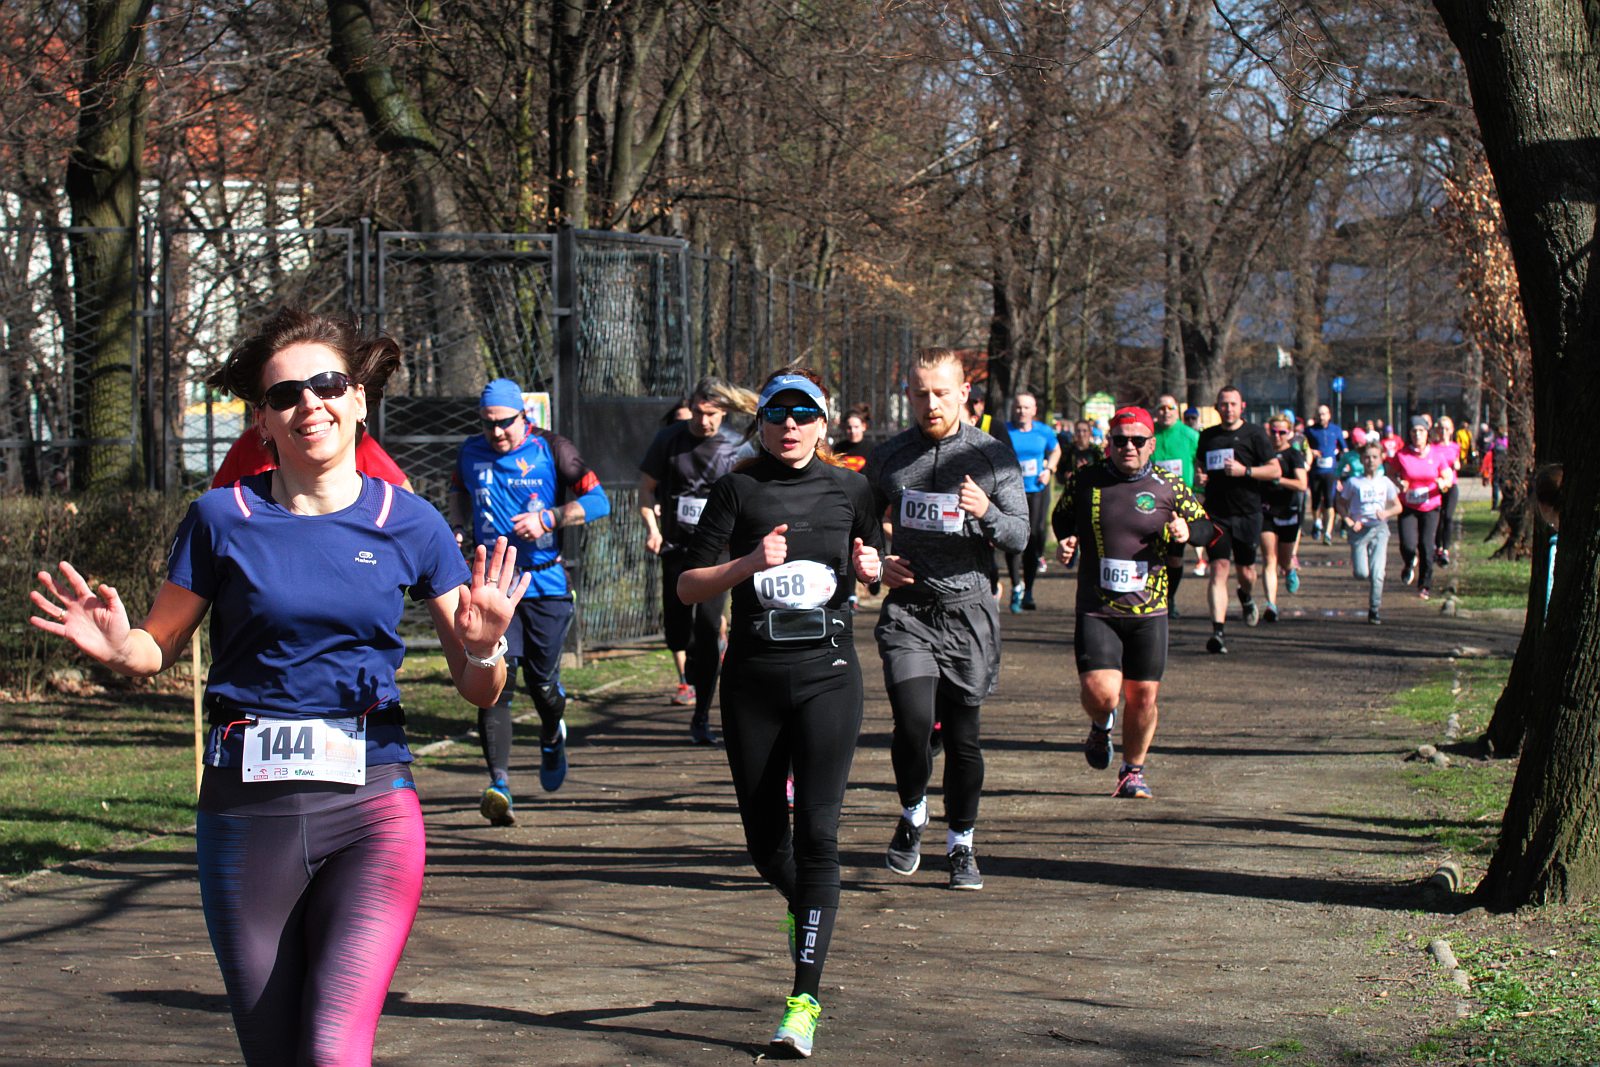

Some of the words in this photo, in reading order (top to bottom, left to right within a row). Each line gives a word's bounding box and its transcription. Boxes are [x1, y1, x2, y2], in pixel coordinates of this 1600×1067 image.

[682, 505, 702, 518] 057
[905, 501, 939, 521] 026
[1103, 567, 1129, 583] 065
[760, 573, 805, 601] 058
[257, 726, 315, 761] 144
